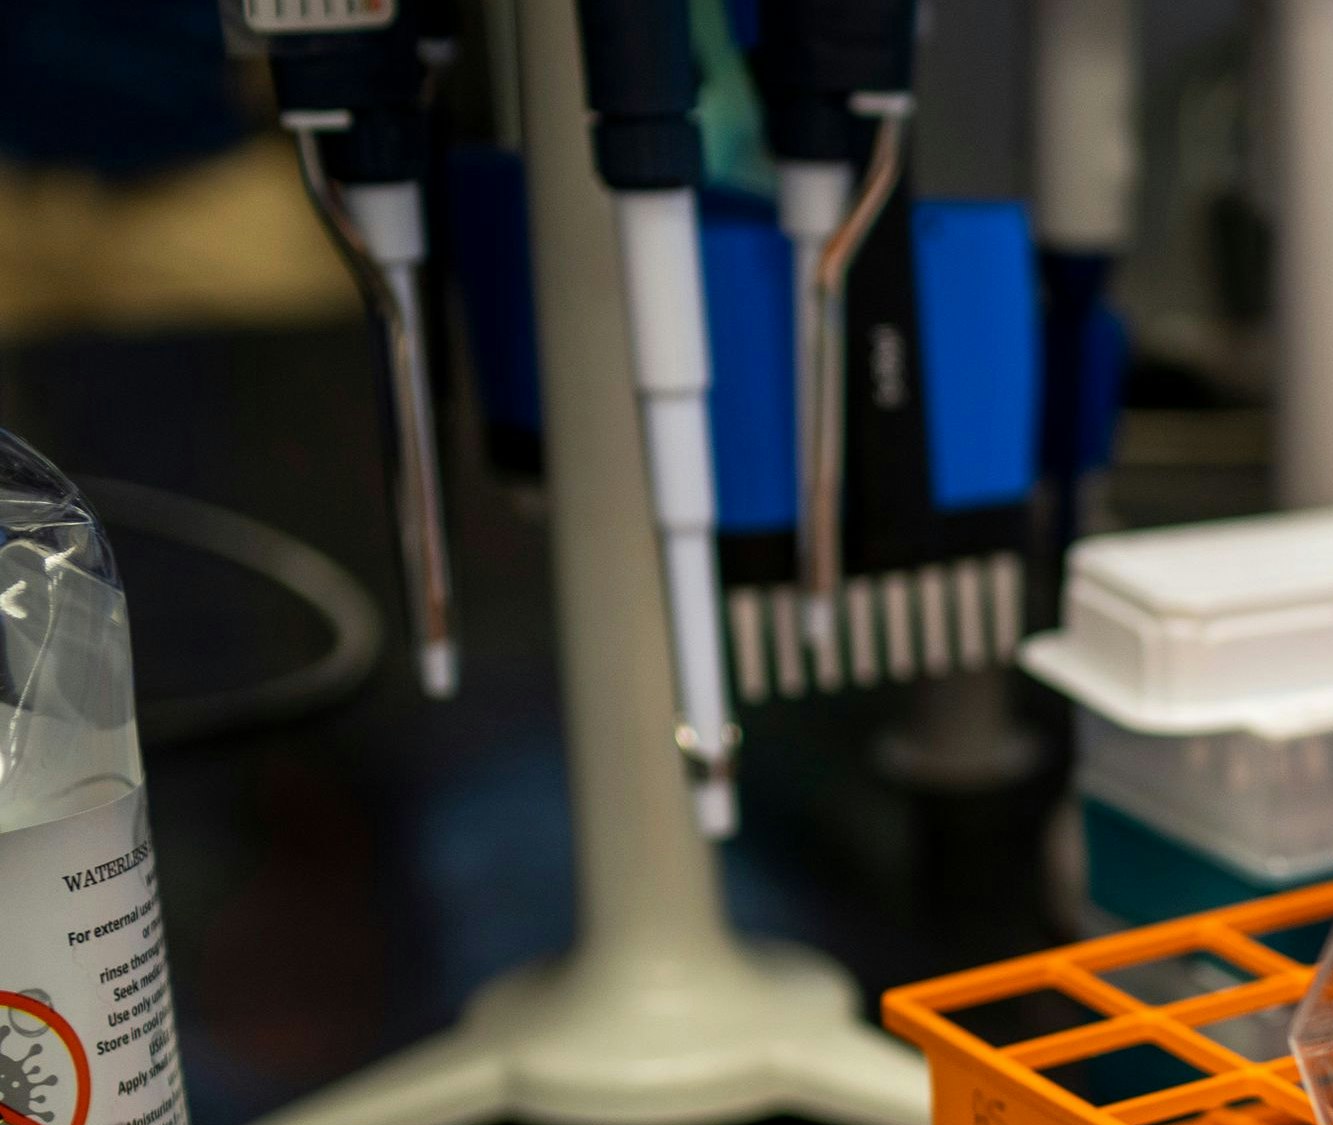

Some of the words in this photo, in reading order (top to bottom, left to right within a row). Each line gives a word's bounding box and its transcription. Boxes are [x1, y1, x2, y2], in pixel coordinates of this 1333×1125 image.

[68, 930, 91, 947] For
[94, 906, 139, 938] external
[99, 962, 128, 984] rinse
[113, 979, 139, 1002] Seek
[107, 1012, 130, 1028] Use
[131, 996, 151, 1014] only
[97, 1033, 129, 1056] Store
[131, 1026, 141, 1041] in
[118, 1070, 148, 1096] Apply
